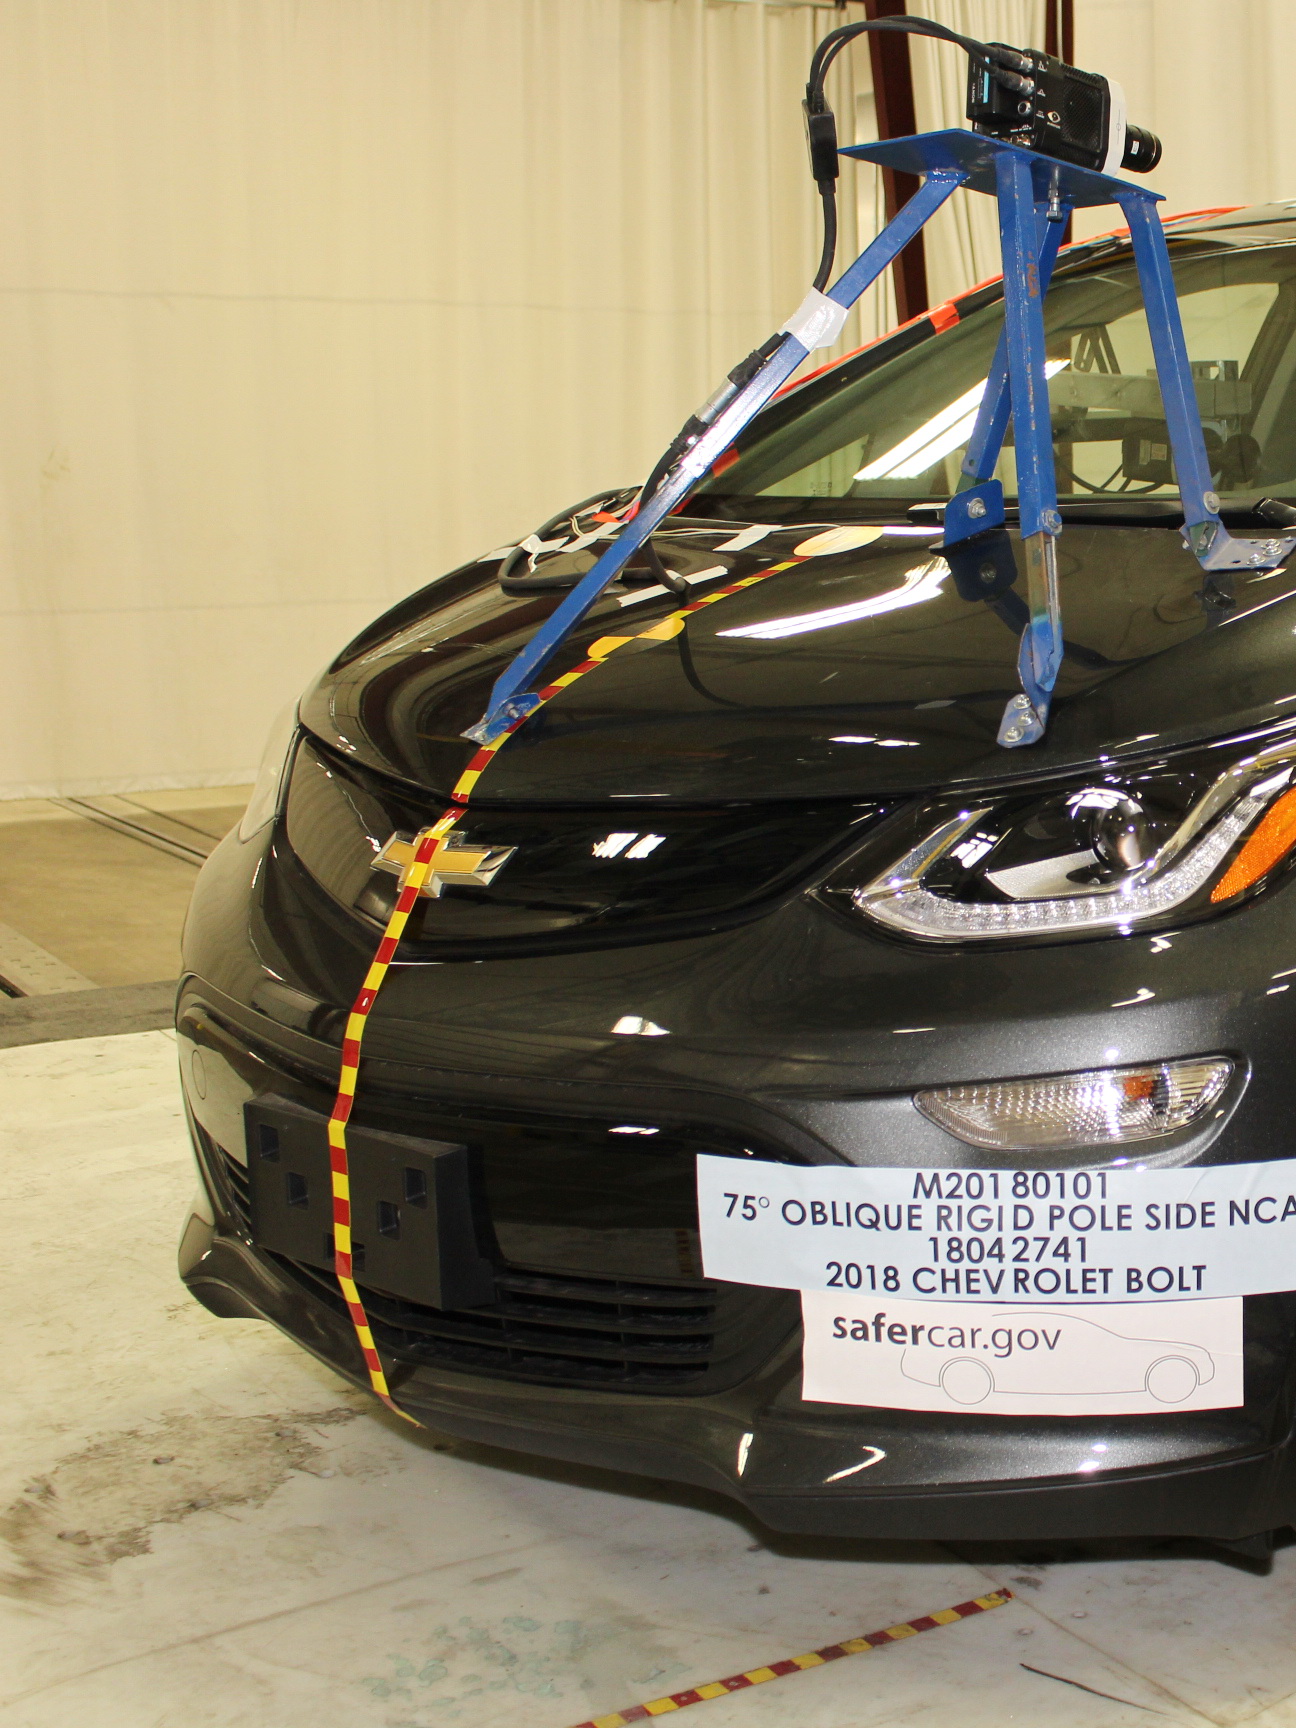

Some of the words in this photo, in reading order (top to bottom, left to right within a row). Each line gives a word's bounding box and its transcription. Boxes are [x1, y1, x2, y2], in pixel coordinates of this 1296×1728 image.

[912, 1171, 1107, 1200] M20180101
[781, 1199, 923, 1232] OBLIQUE
[936, 1204, 1035, 1233] RIGID
[1048, 1204, 1133, 1232] POLE
[1145, 1200, 1217, 1231] SIDE
[928, 1236, 1088, 1264] 18042741
[825, 1261, 902, 1293] 2018
[912, 1267, 1114, 1295] CHEVROLET
[1126, 1264, 1208, 1294] BOLT
[832, 1312, 1062, 1358] safercar.gov
